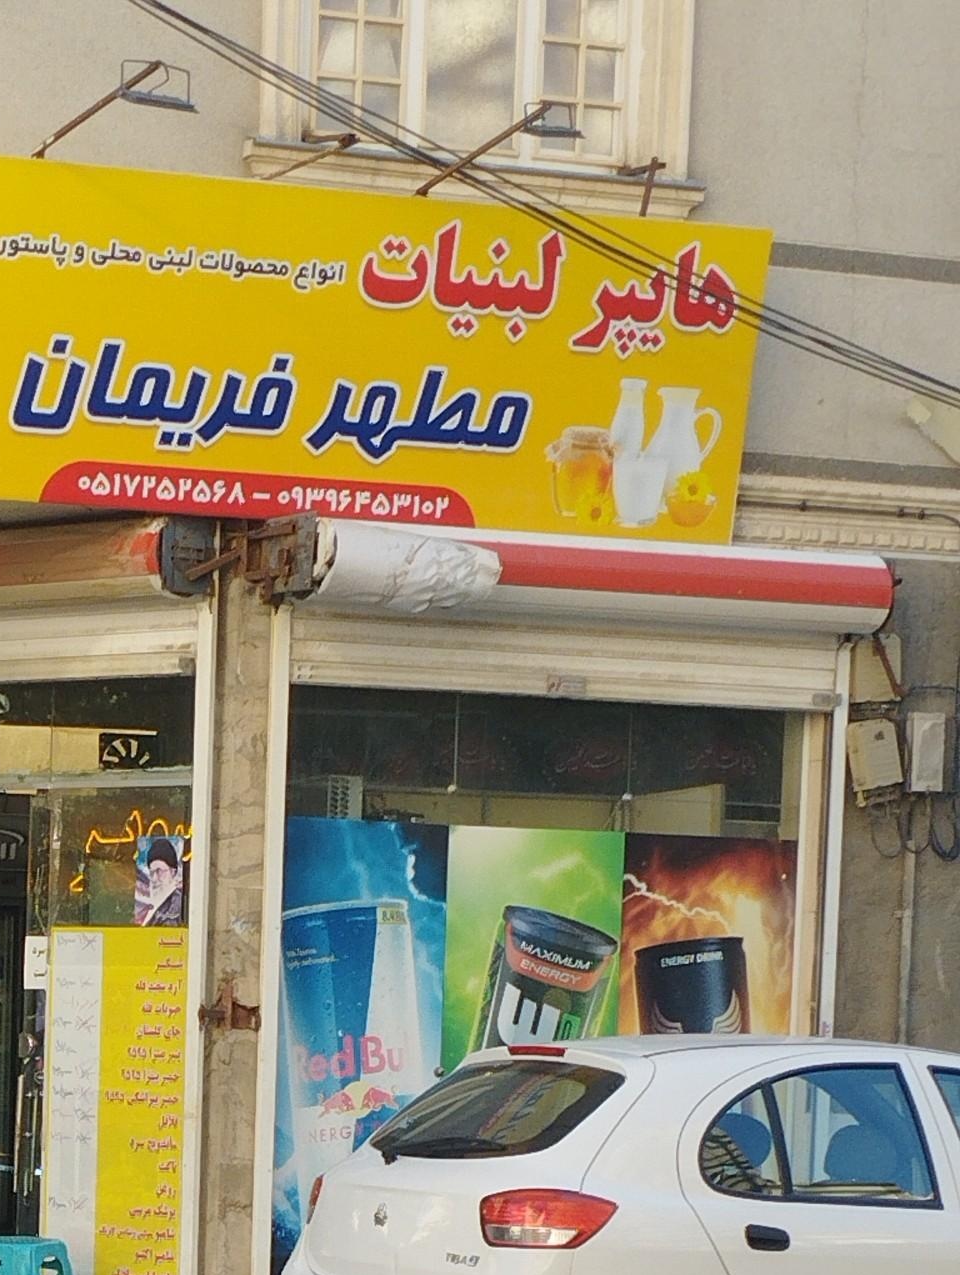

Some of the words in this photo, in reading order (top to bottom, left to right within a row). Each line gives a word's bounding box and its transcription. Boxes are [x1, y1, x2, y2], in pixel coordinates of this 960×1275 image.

[74, 243, 86, 264] و
[91, 241, 142, 266] محلی
[149, 247, 193, 274] لبنی
[200, 250, 290, 278] محصولات
[294, 261, 345, 289] انواع
[360, 221, 564, 342] لبنیات
[571, 242, 738, 357] هایپر
[11, 334, 296, 448] فریمان
[303, 366, 533, 460] مطهر
[519, 940, 593, 970] MAXIMUM
[519, 958, 581, 985] ENERGY
[361, 1035, 406, 1075] Bu
